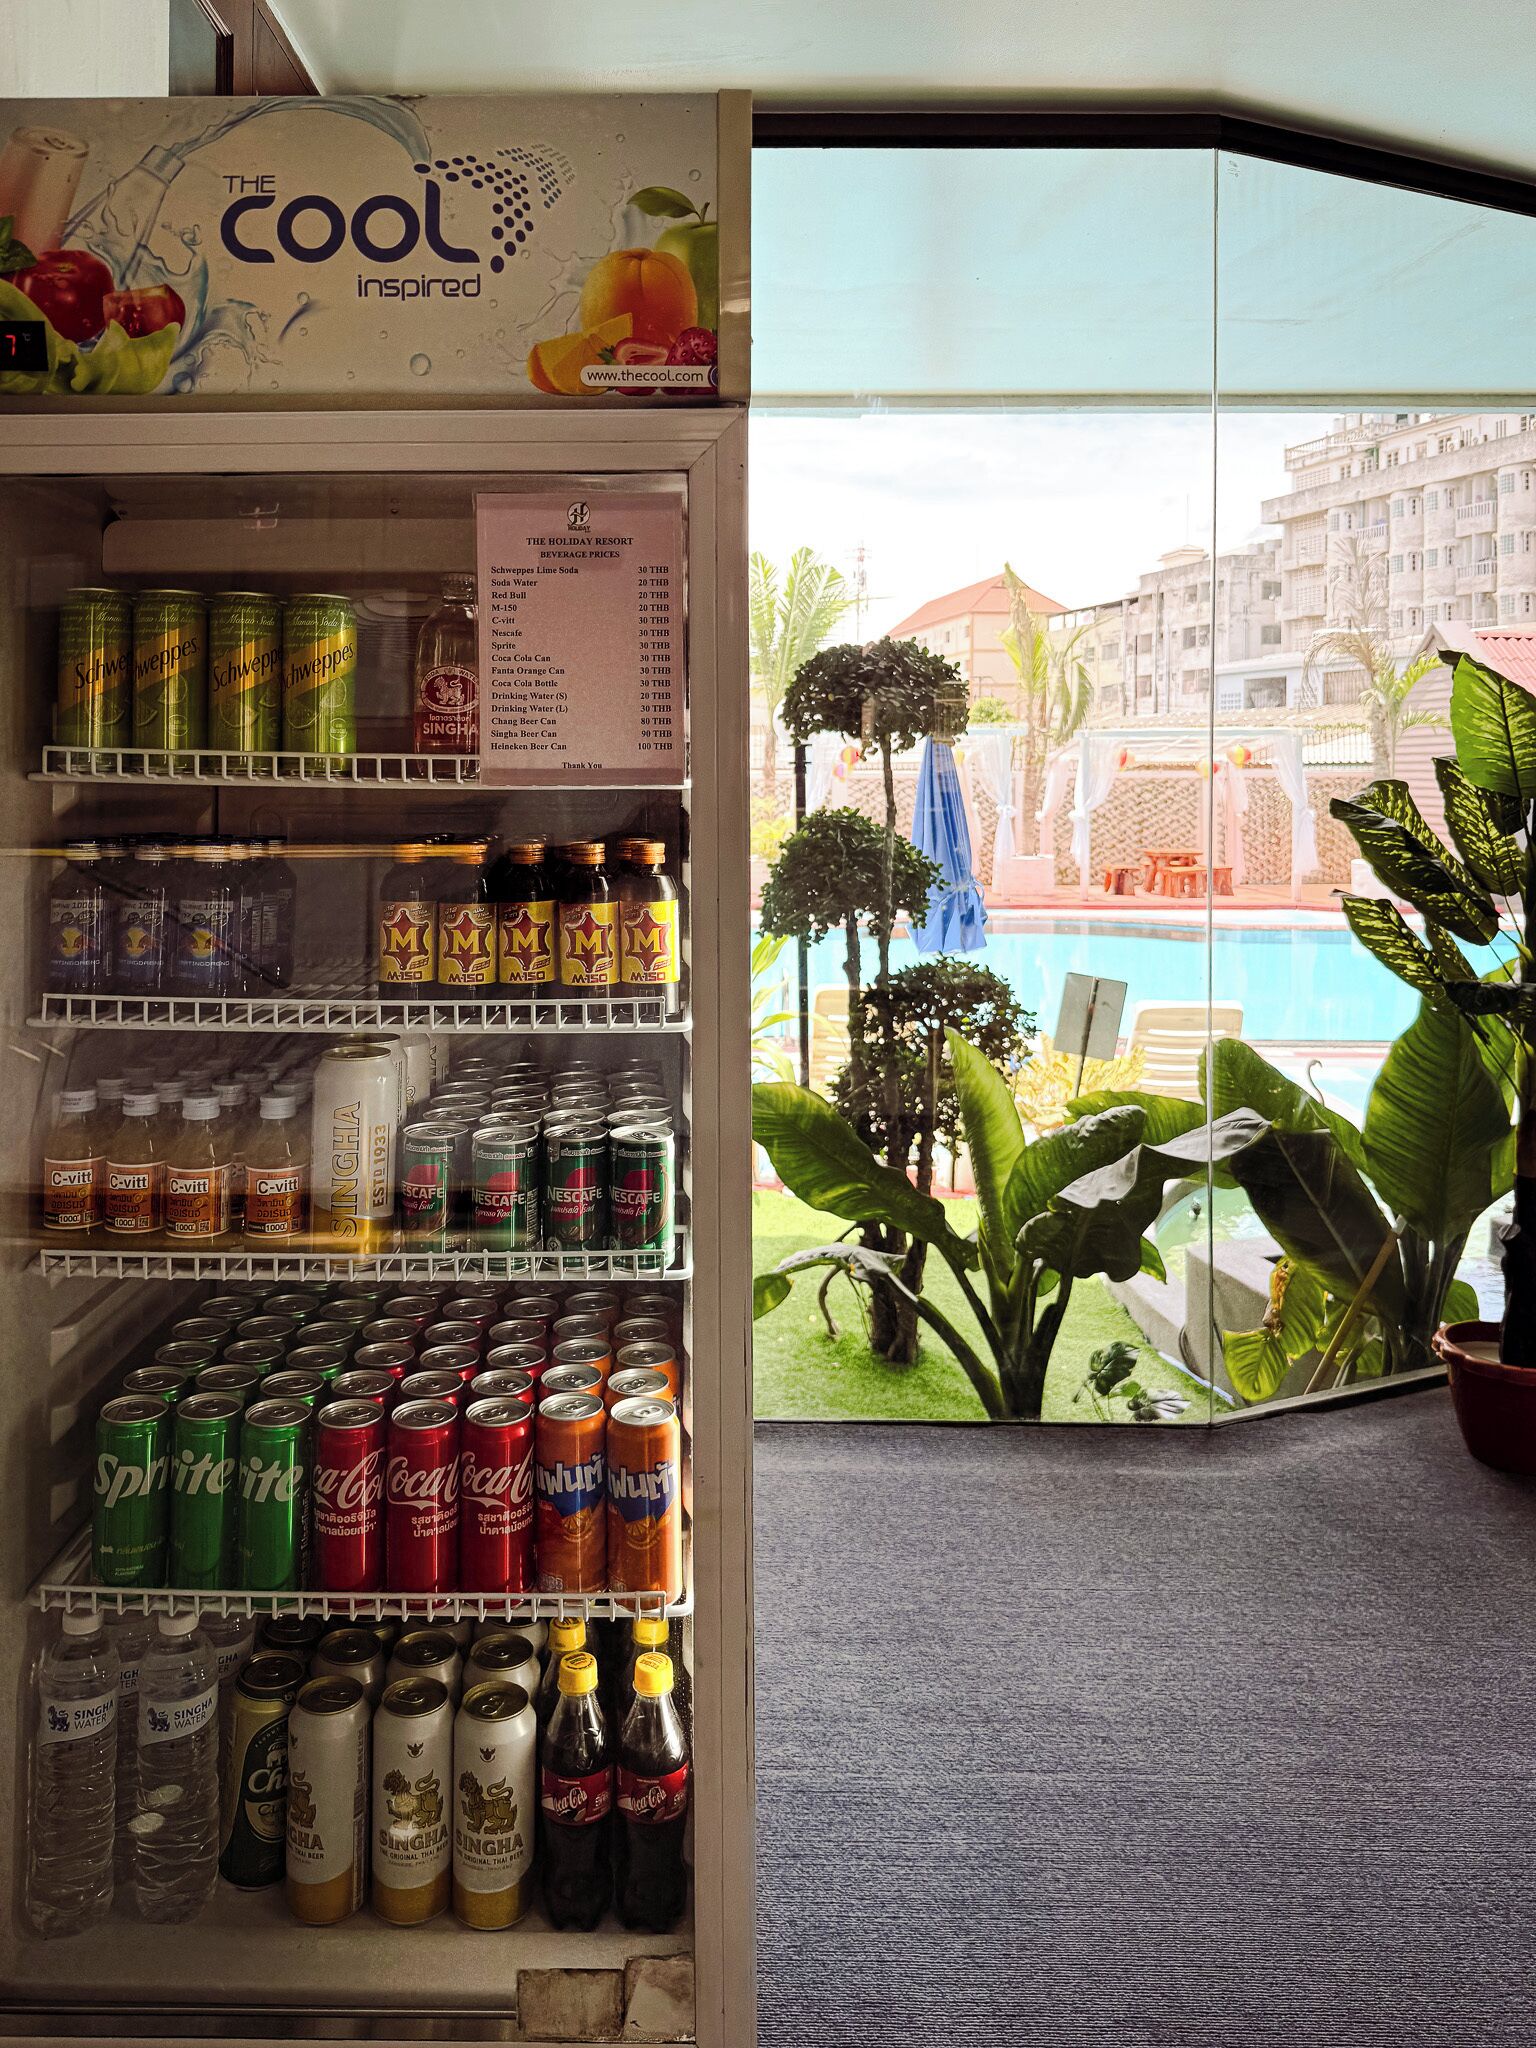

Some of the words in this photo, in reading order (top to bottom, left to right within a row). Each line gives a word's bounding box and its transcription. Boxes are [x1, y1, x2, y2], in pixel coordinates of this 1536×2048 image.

[222, 175, 276, 193] THE
[357, 273, 481, 301] inspired
[4, 334, 17, 357] 7
[586, 369, 704, 382] www.thecool.com
[526, 538, 546, 546] THE
[548, 537, 593, 546] HOLIDAY
[595, 537, 634, 546] RESORT
[540, 551, 587, 559] BEVERAGE
[589, 551, 620, 559] PRICES
[491, 566, 534, 577] Schweppes
[537, 566, 557, 575] Lime
[559, 566, 579, 575] Soda
[638, 566, 647, 574] 30
[649, 566, 669, 574] THB
[491, 579, 511, 588] Soda
[513, 579, 538, 588] Water
[638, 579, 647, 587] 20
[649, 579, 669, 587] THB
[492, 592, 507, 601] Red
[510, 592, 526, 601] Bull
[638, 592, 648, 600] 20
[649, 592, 669, 600] THB
[491, 604, 518, 613] M-150
[639, 604, 648, 612] 20
[650, 604, 669, 612] THB
[492, 617, 515, 626] C-vitt
[639, 617, 648, 625] 30
[650, 617, 669, 625] THB
[492, 630, 522, 639] Nescafe
[639, 630, 648, 638] 30
[650, 630, 669, 638] THB
[491, 642, 516, 652] Sprite
[639, 642, 649, 650] 30
[650, 642, 670, 650] THB
[491, 655, 511, 663] Coca
[514, 655, 532, 663] Cola
[534, 655, 551, 663] Can
[640, 655, 649, 663] 30
[651, 655, 671, 663] THB
[491, 667, 514, 676] Fanta
[517, 667, 546, 677] Orange
[549, 667, 565, 676] Can
[640, 667, 649, 675] 30
[651, 667, 671, 675] THB
[491, 680, 511, 688] Coca
[514, 680, 532, 688] Cola
[534, 680, 558, 688] Bottle
[640, 680, 650, 688] 30
[651, 680, 671, 688] THB
[491, 692, 528, 702] Drinking
[530, 692, 554, 700] Water
[556, 692, 568, 701] (S)
[640, 692, 650, 700] 20
[651, 692, 671, 700] THB
[491, 705, 527, 715] Drinking
[530, 705, 554, 713] Water
[556, 705, 568, 714] (L)
[641, 705, 650, 713] 30
[652, 705, 671, 713] THB
[491, 718, 518, 728] Chang
[520, 718, 538, 726] Beer
[540, 718, 557, 726] Can
[641, 718, 650, 726] 80
[652, 718, 671, 726] THB
[491, 730, 518, 740] Singha
[520, 730, 539, 738] Beer
[541, 730, 557, 738] Can
[642, 730, 651, 738] 90
[653, 730, 672, 738] THB
[490, 743, 528, 751] Heineken
[530, 743, 548, 751] Beer
[551, 743, 567, 751] Can
[638, 743, 651, 751] 100
[653, 743, 673, 751] THB
[389, 927, 420, 953] M
[450, 929, 482, 955] M
[510, 927, 542, 954] M
[573, 929, 605, 955] M
[631, 927, 663, 954] M
[373, 1125, 386, 1166] 1933
[330, 1100, 361, 1238] SINGHA
[52, 1170, 92, 1186] C-vitt
[110, 1174, 147, 1188] C-vitt
[170, 1179, 208, 1193] C-vitt
[258, 1178, 298, 1194] C-vitt
[74, 1700, 114, 1720] SINGHA
[174, 1697, 213, 1720] SINGHA
[74, 1713, 108, 1730] WATER
[174, 1712, 206, 1729] WATER
[379, 1823, 449, 1851] SINGHA
[455, 1828, 524, 1856] SINGHA
[307, 1852, 325, 1860] BEER
[389, 1852, 419, 1861] ORIGINAL
[421, 1849, 435, 1859] THAI
[464, 1854, 490, 1865] ORIGINAL
[493, 1857, 508, 1865] THAI
